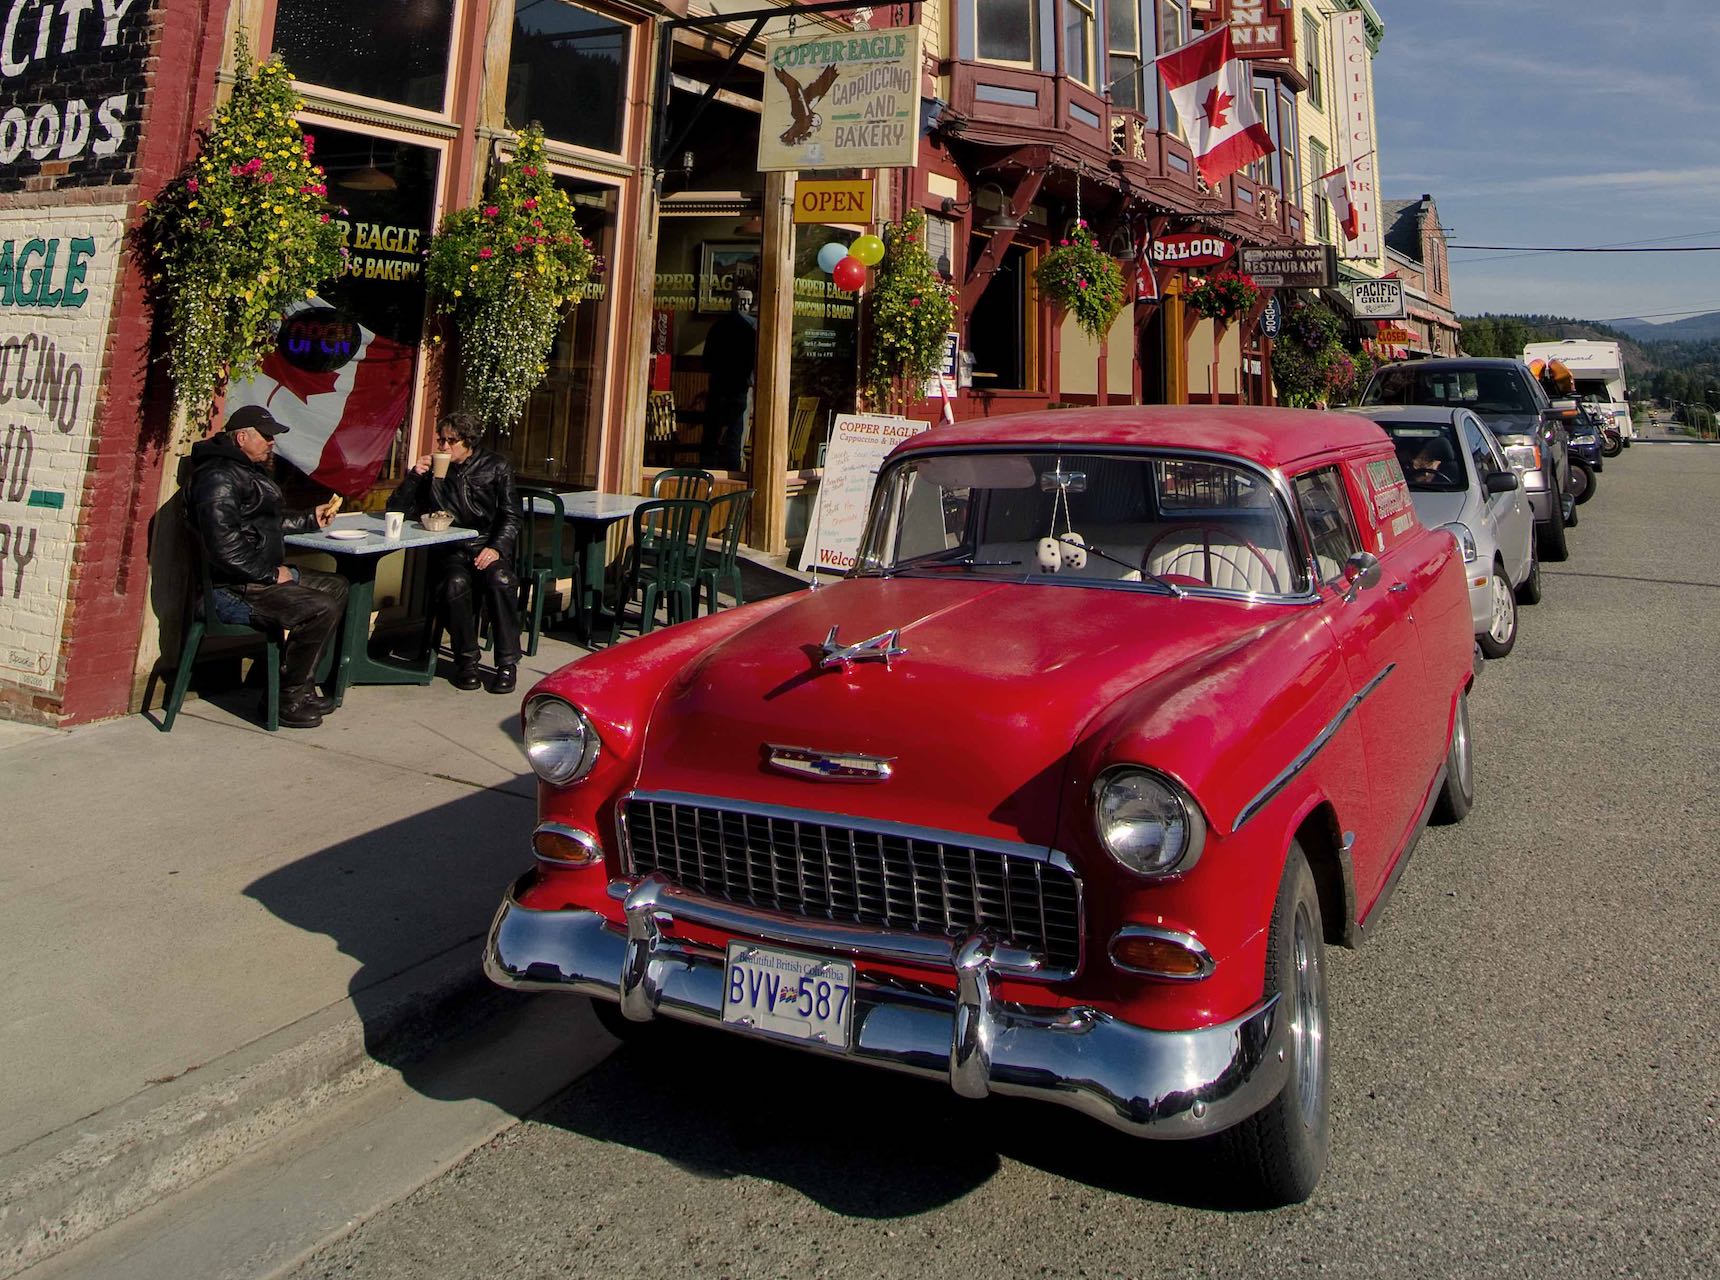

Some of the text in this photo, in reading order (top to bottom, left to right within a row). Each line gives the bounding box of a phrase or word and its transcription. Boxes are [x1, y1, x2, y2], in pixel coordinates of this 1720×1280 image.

[1231, 25, 1277, 45] NN
[773, 35, 906, 68] COPPER EAGLE
[832, 67, 911, 106] CAPPUCCINO
[1347, 15, 1370, 142] PACIFIC
[864, 95, 896, 119] AND
[0, 94, 128, 164] OODS
[835, 123, 904, 148] BAKERY
[802, 191, 864, 212] OPEN
[1355, 161, 1377, 253] GRILL
[353, 222, 420, 255] EAGLE
[1154, 238, 1225, 261] SALOON
[0, 236, 95, 308] AGLE
[352, 256, 363, 277] &
[365, 258, 420, 281] BAKERY
[1244, 260, 1323, 273] RESTAURANT
[581, 282, 606, 300] KERY
[655, 273, 734, 291] PPER EAG
[794, 277, 825, 297] OPPER
[1356, 282, 1398, 297] PACIFIC
[654, 296, 696, 311] UCCINO
[794, 300, 825, 318] PPUCCINO
[832, 304, 855, 319] BAKERY
[1378, 331, 1406, 342] CLOSED
[0, 332, 82, 433] CCINO
[839, 421, 918, 438] COPPER EAGLE
[839, 433, 879, 444] Cappuccino
[820, 549, 856, 568] Welco
[740, 951, 844, 982] Beautiful British Columbia
[729, 965, 850, 1025] BVV 587
